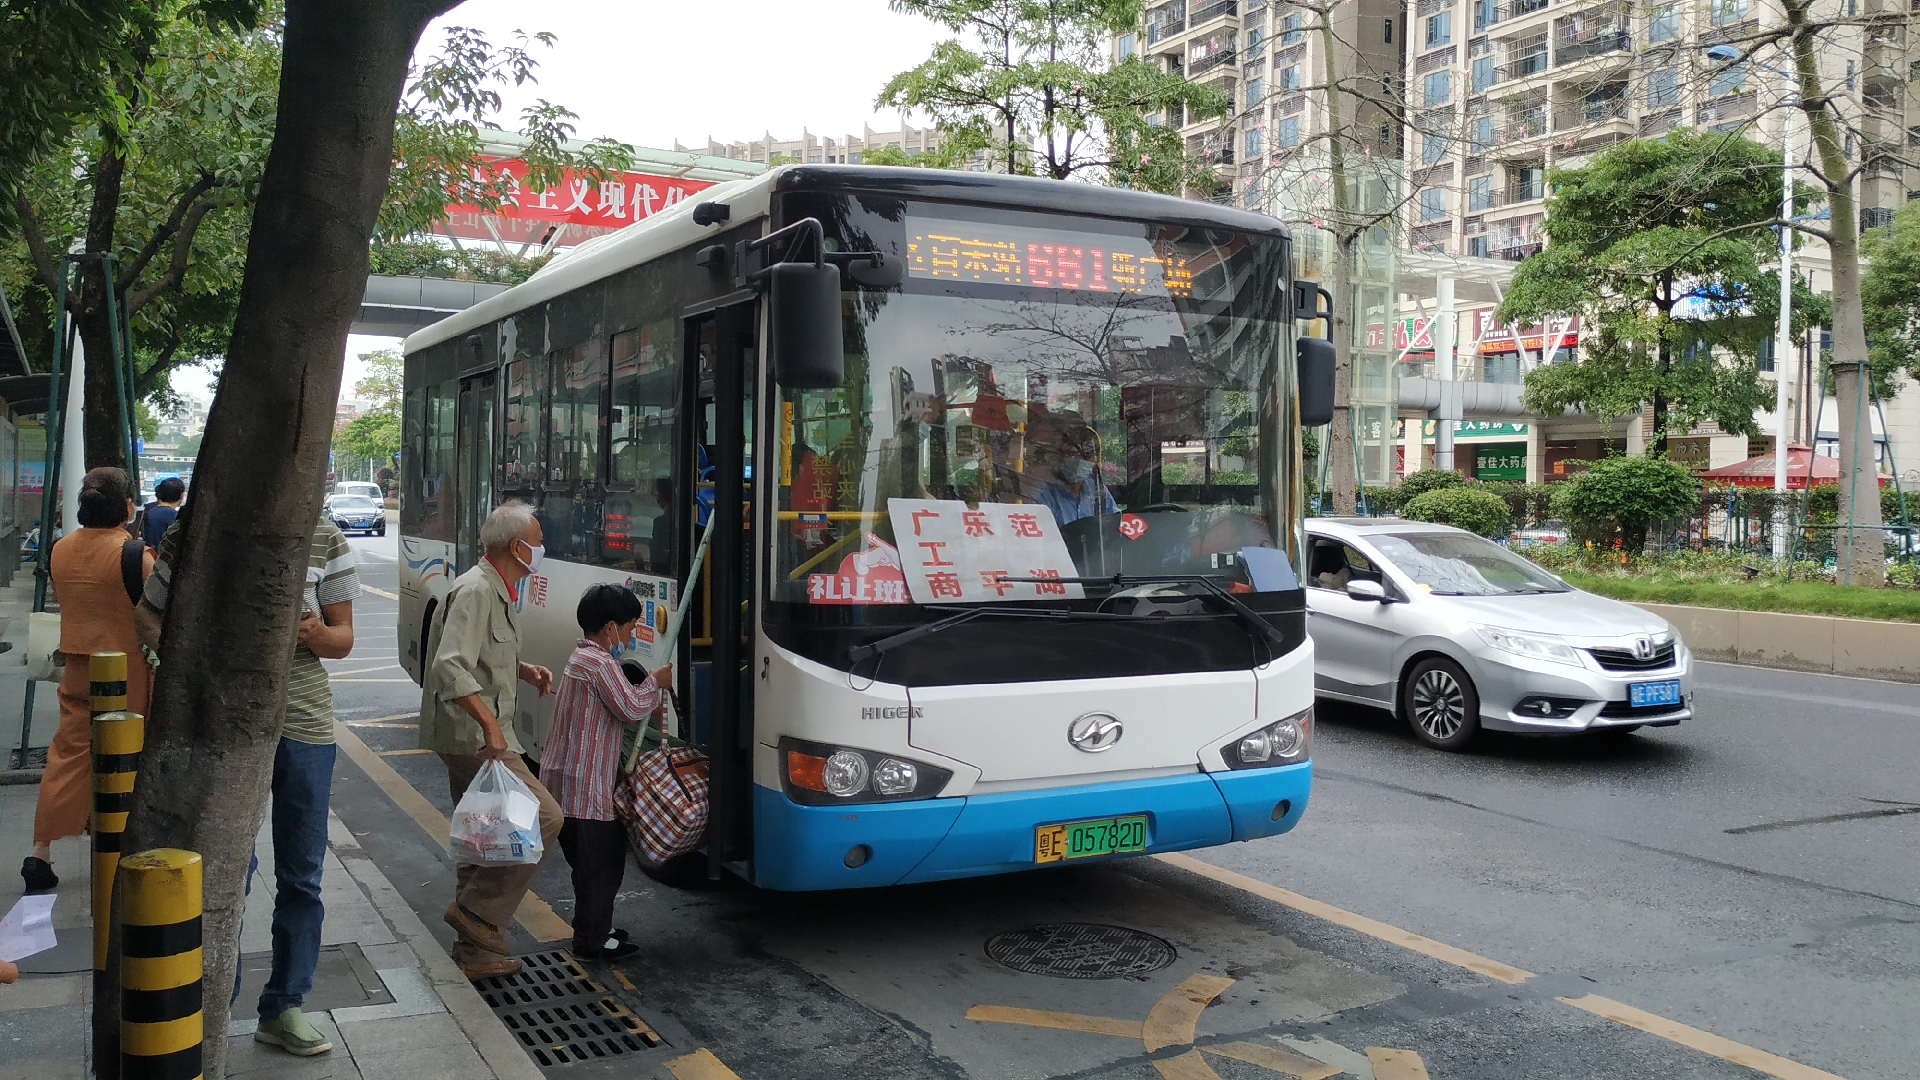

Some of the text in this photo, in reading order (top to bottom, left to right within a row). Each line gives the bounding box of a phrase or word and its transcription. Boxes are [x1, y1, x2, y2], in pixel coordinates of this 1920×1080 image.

[1027, 243, 1108, 292] 661
[1120, 518, 1145, 536] 32
[861, 706, 924, 720] HIGER
